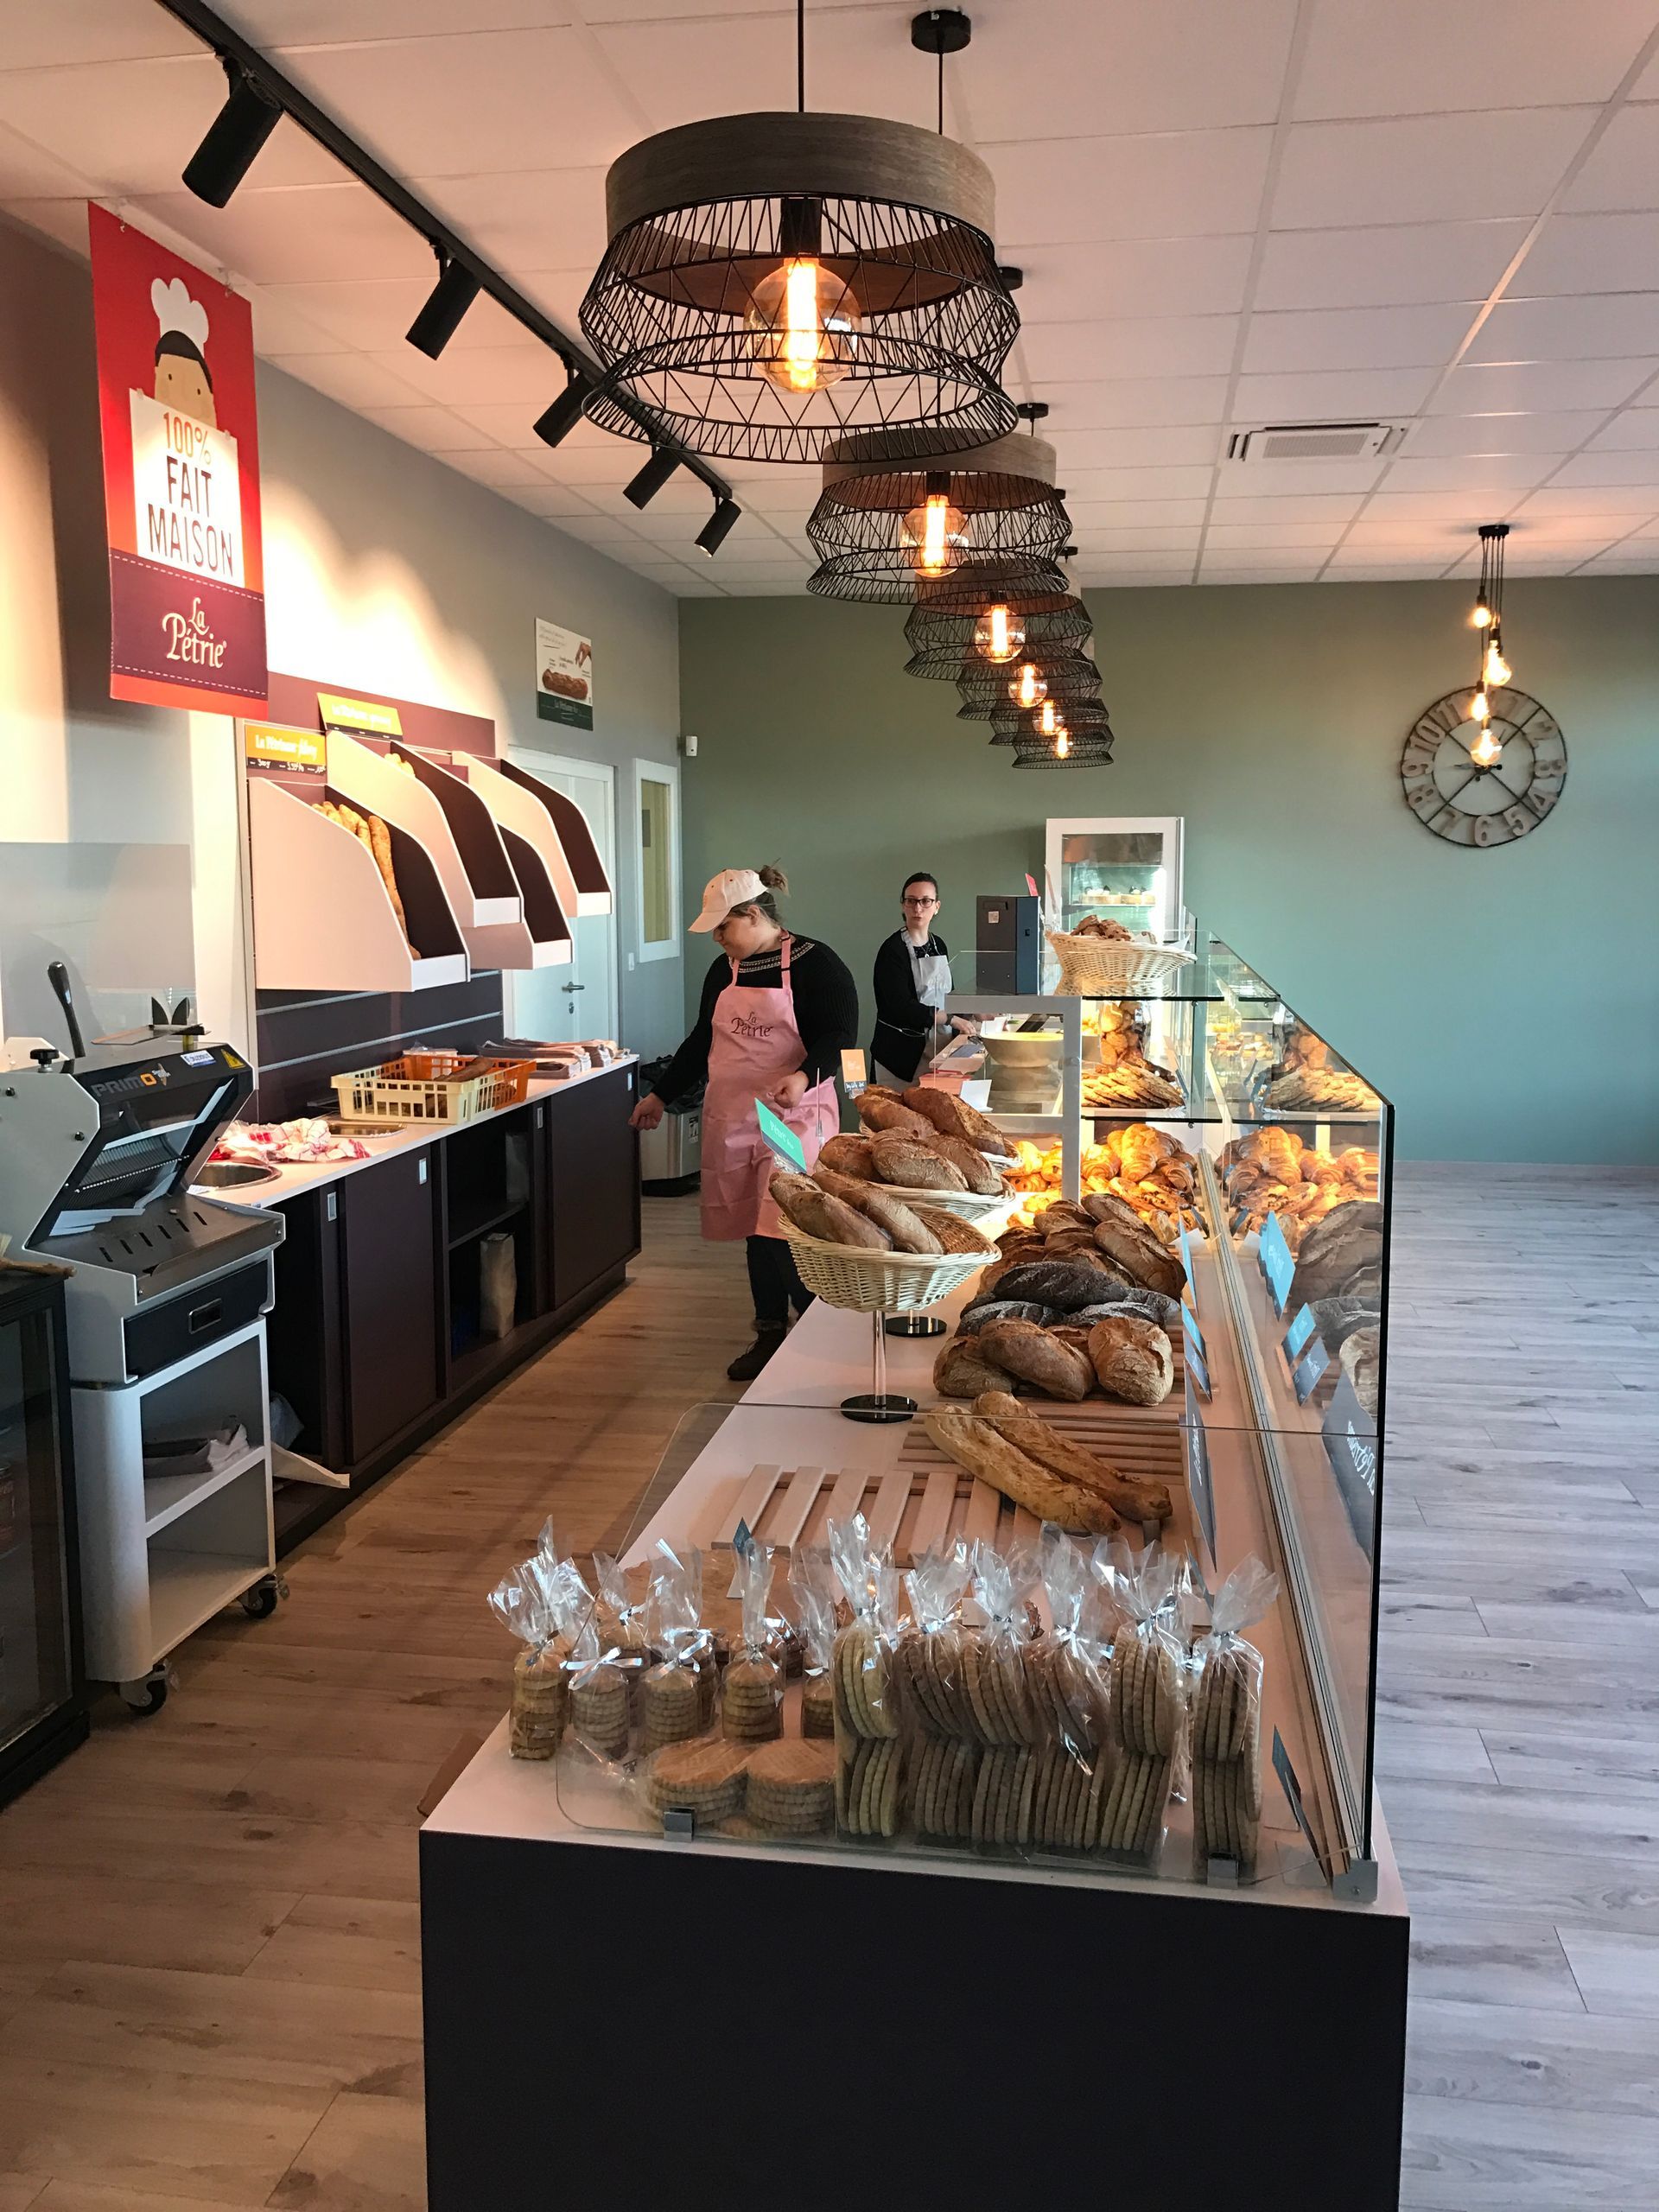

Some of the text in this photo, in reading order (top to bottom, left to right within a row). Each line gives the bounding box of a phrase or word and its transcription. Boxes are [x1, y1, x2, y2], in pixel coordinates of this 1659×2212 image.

[163, 411, 212, 466] 100%
[166, 454, 212, 518] FAIT
[148, 503, 233, 577] MAISON
[188, 597, 210, 635] La
[162, 612, 225, 669] Pétrie
[1408, 717, 1446, 753] 10
[1401, 760, 1433, 778] 9
[1474, 815, 1493, 848] 6
[1503, 804, 1531, 836] 5
[746, 1011, 760, 1026] La
